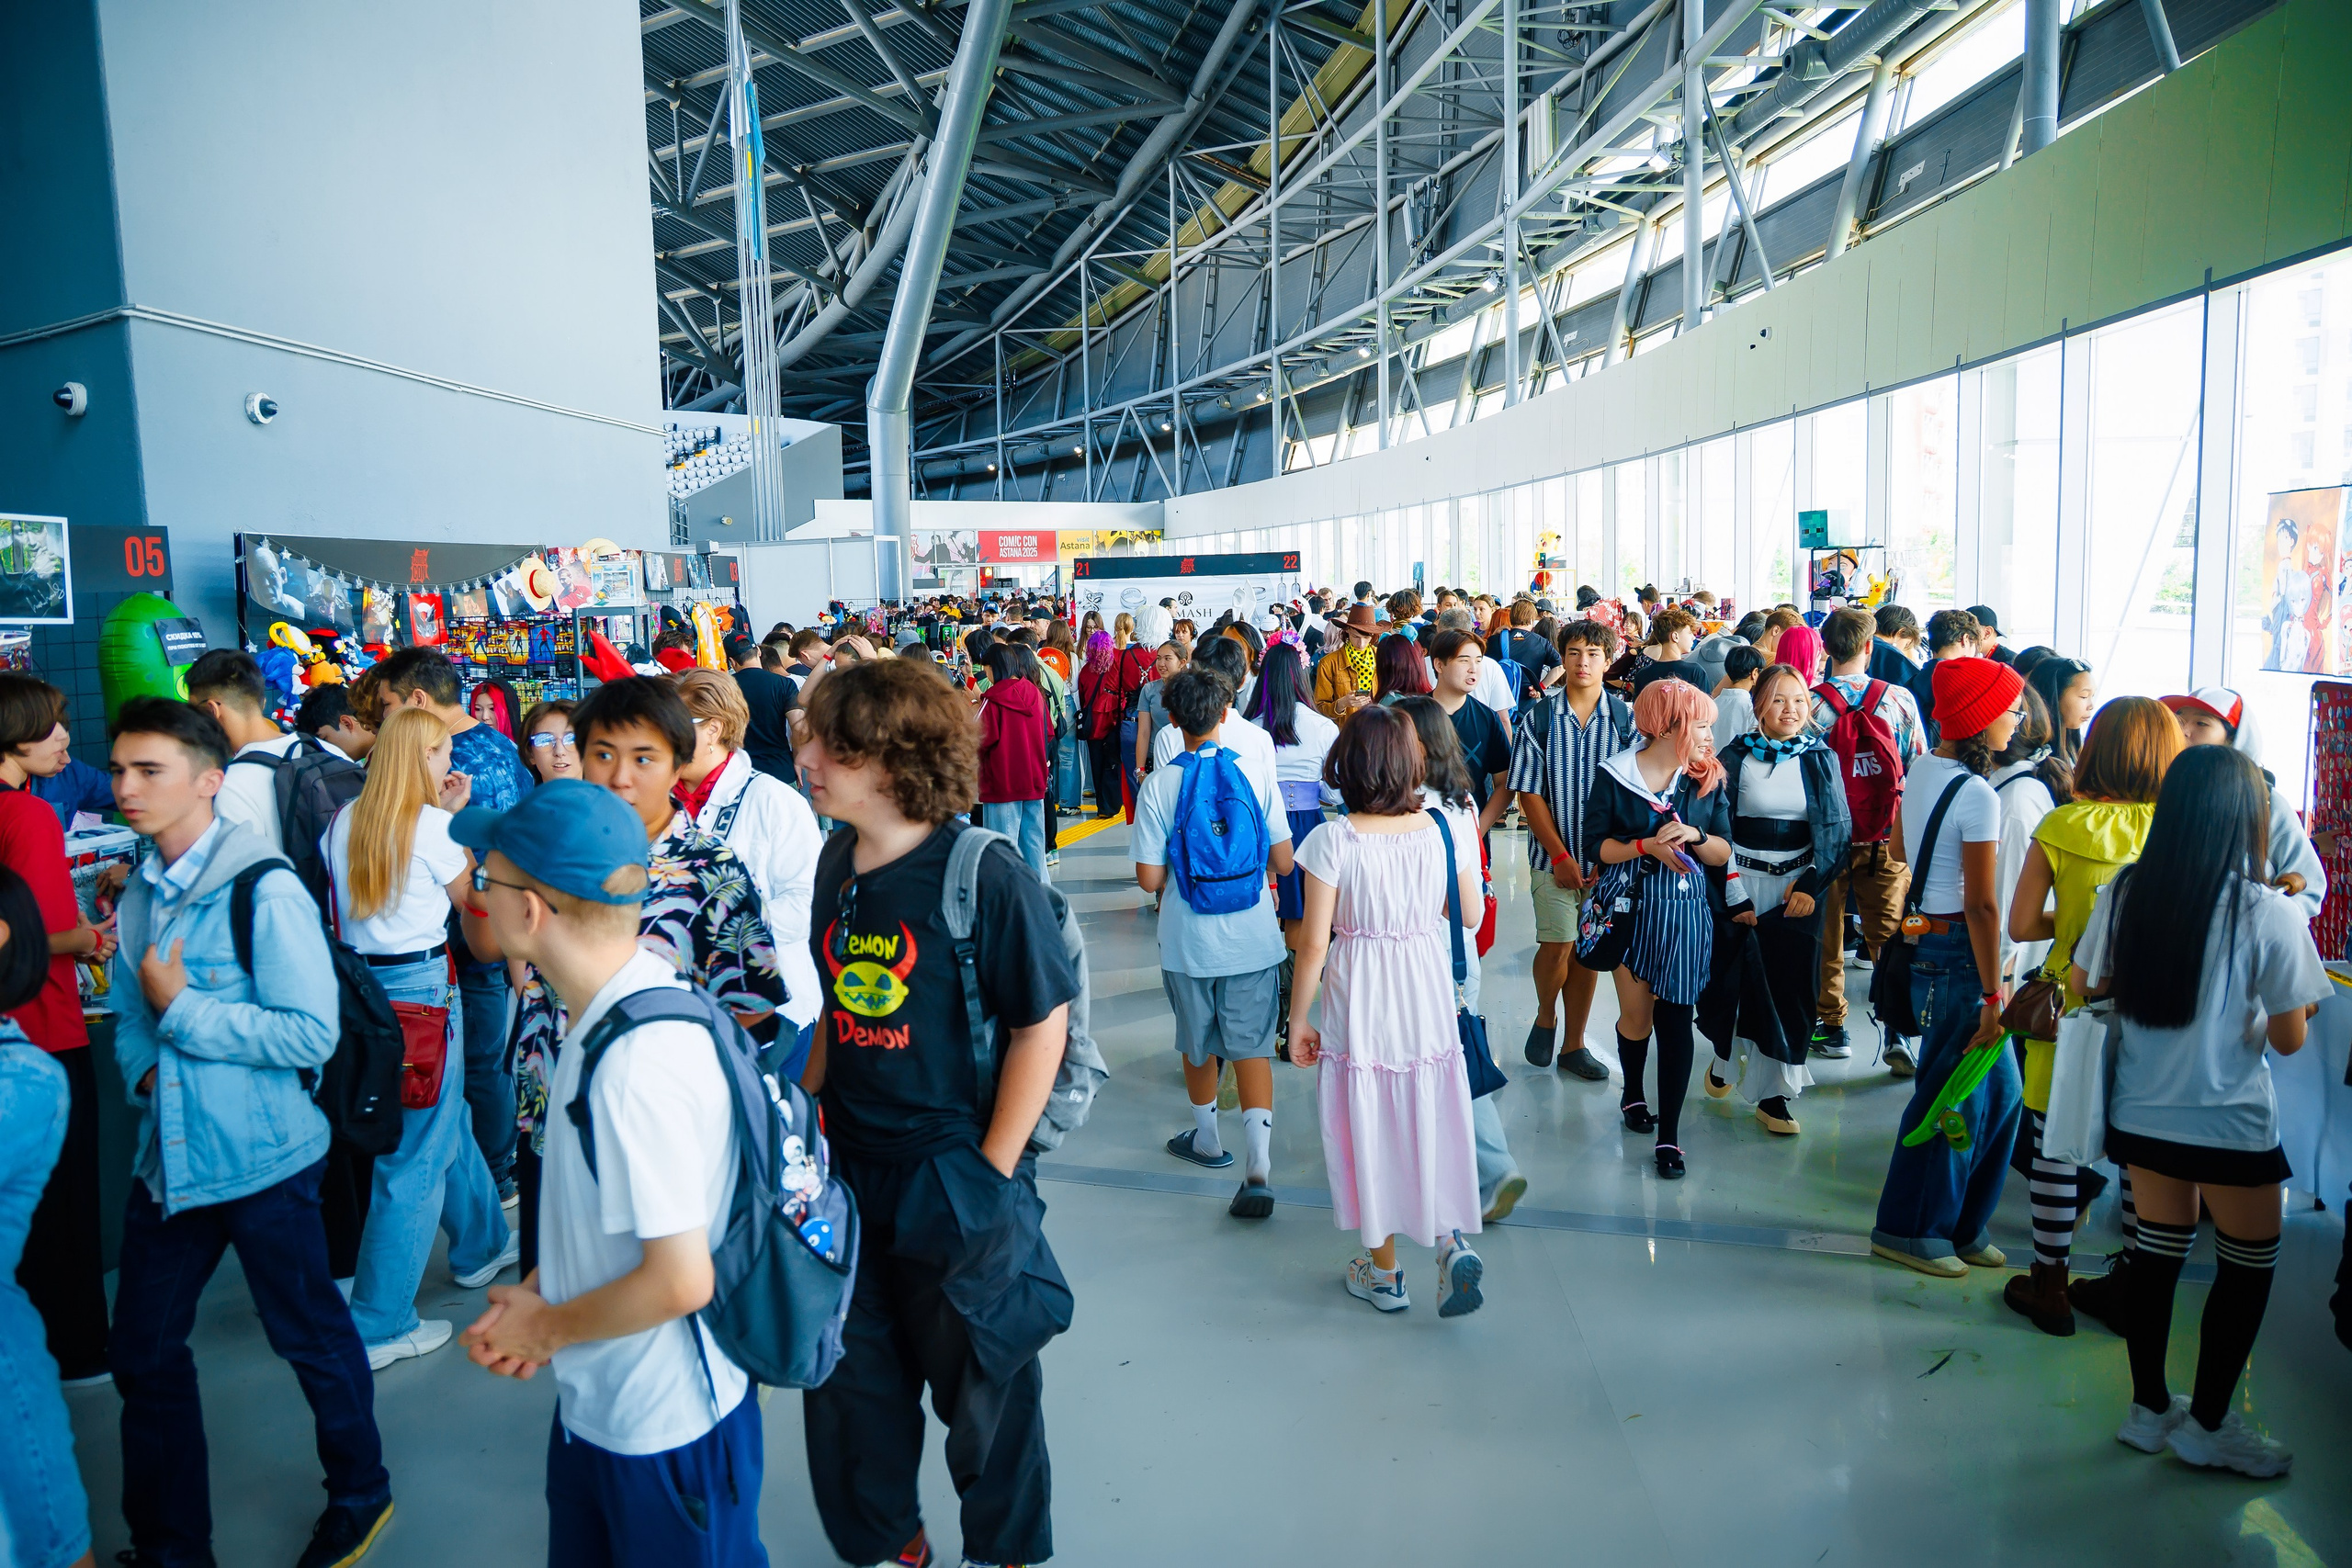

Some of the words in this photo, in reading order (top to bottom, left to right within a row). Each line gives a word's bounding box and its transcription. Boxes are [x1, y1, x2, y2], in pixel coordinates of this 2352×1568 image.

[1023, 536, 1037, 547] CON
[124, 536, 164, 577] 05
[999, 547, 1022, 558] ASTANA
[1022, 547, 1037, 558] 2025
[1076, 562, 1090, 576] 21
[1283, 555, 1297, 570] 22
[729, 562, 739, 581] 03
[1176, 608, 1212, 617] MASH
[165, 632, 193, 641] СКИДКА
[1852, 750, 1883, 778] ANS
